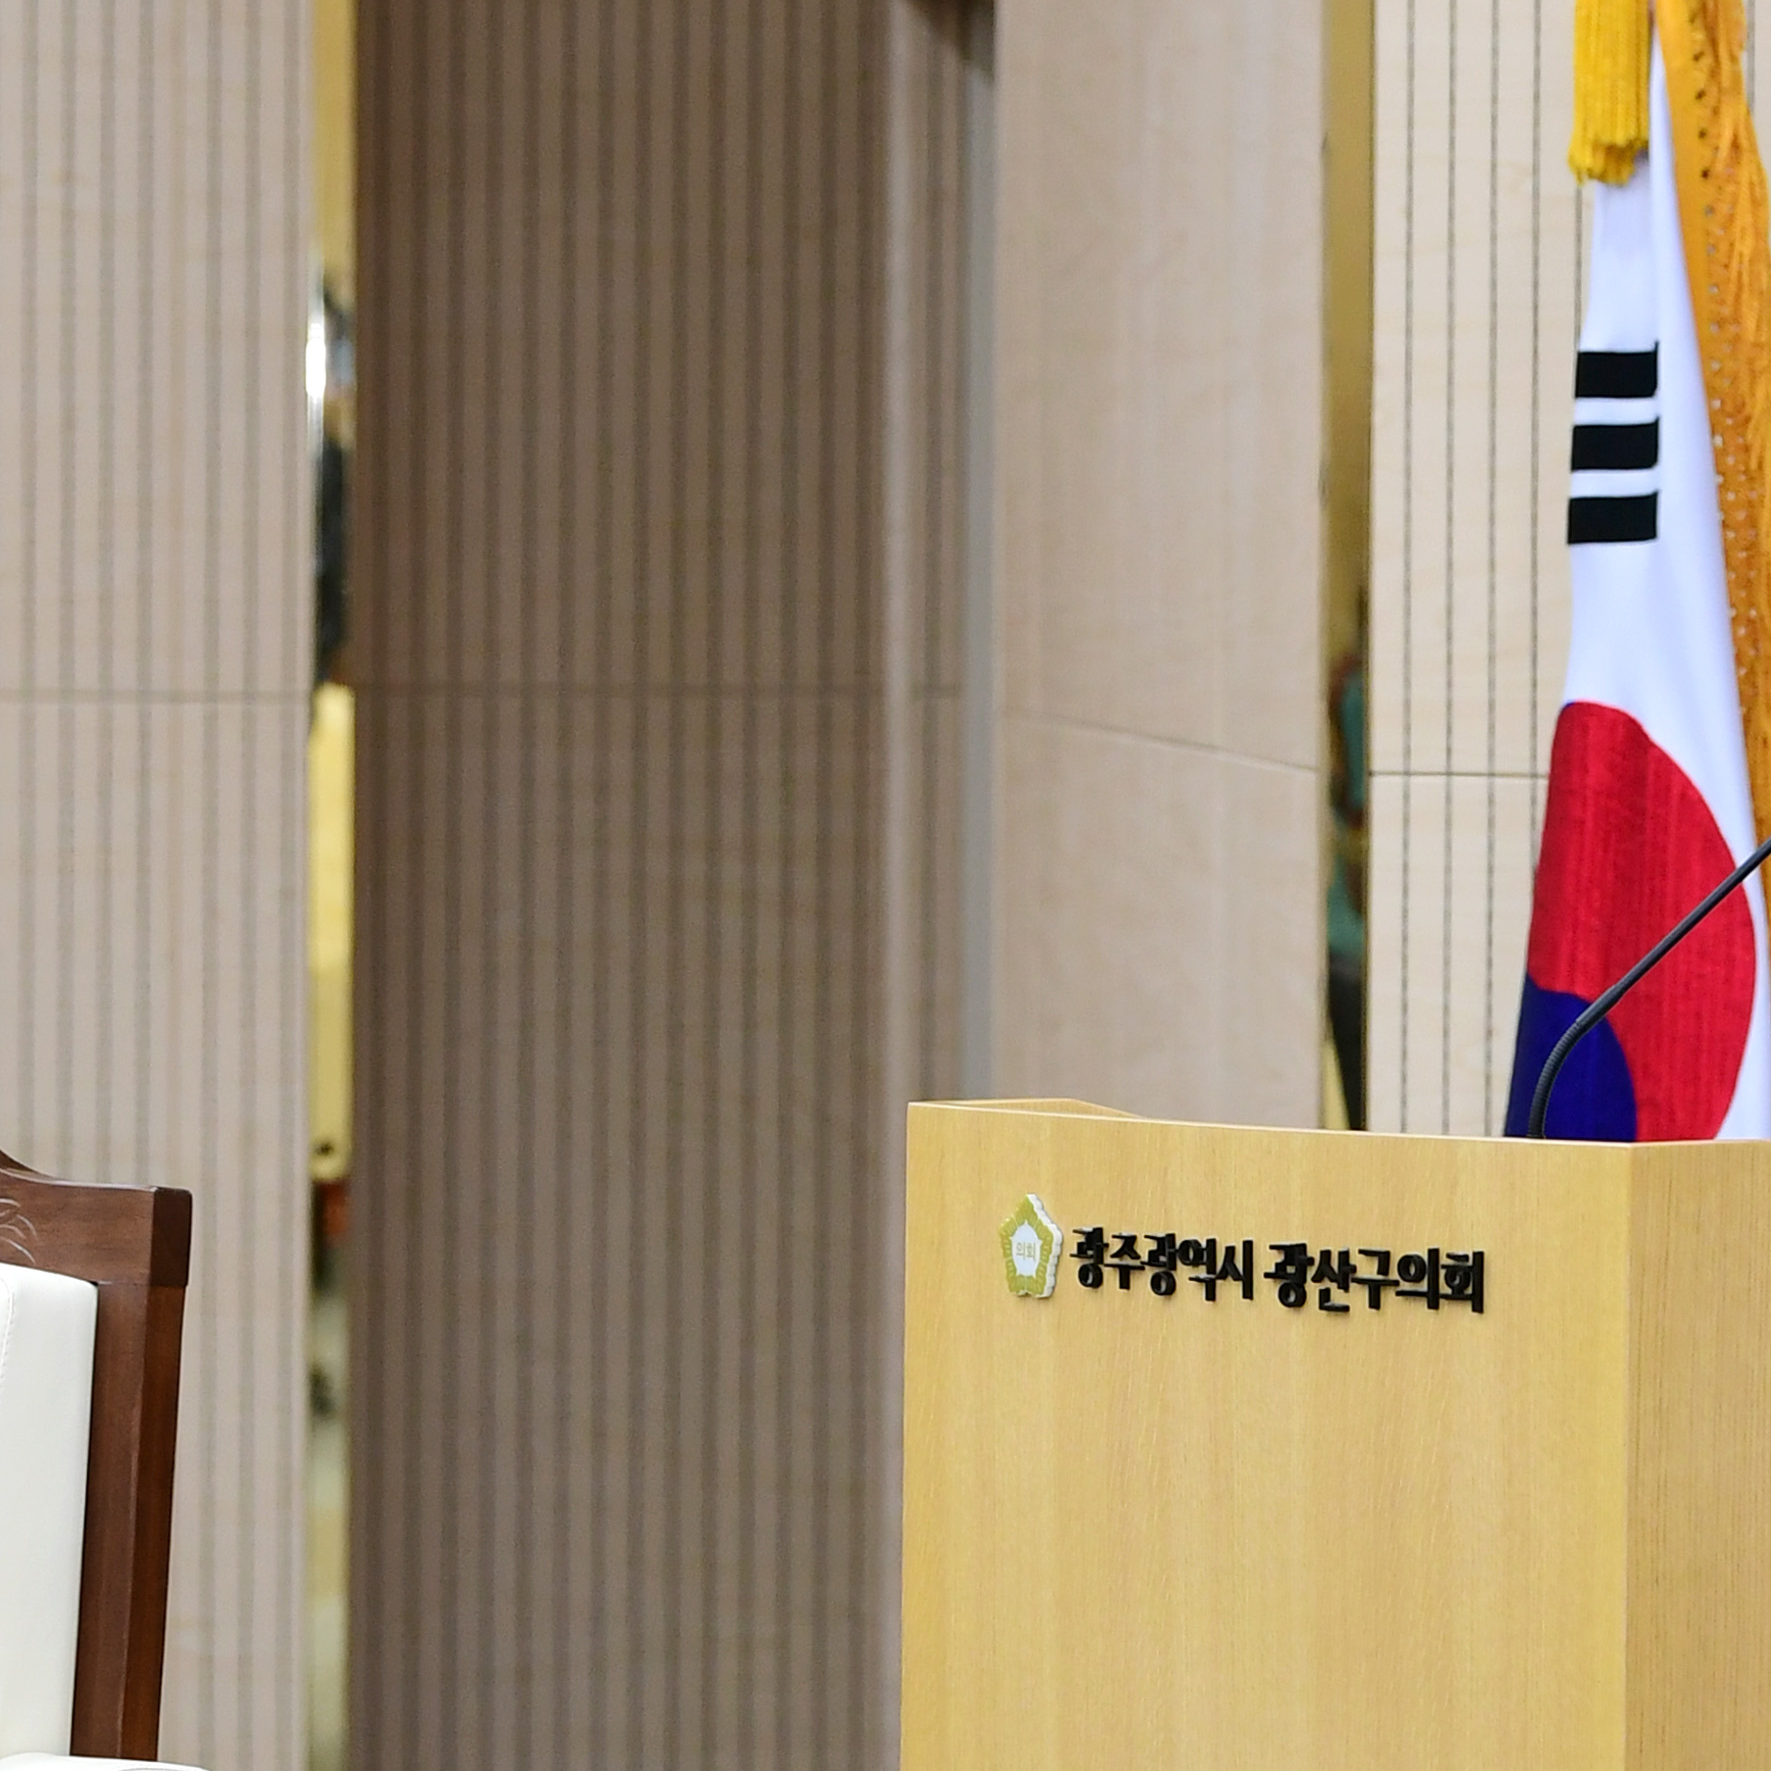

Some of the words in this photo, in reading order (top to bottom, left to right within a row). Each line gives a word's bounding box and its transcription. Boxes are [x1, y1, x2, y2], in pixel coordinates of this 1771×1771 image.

[1015, 1238, 1037, 1261] 의회
[1069, 1226, 1254, 1302] 광주광역시
[1263, 1241, 1486, 1314] 광산구의회
